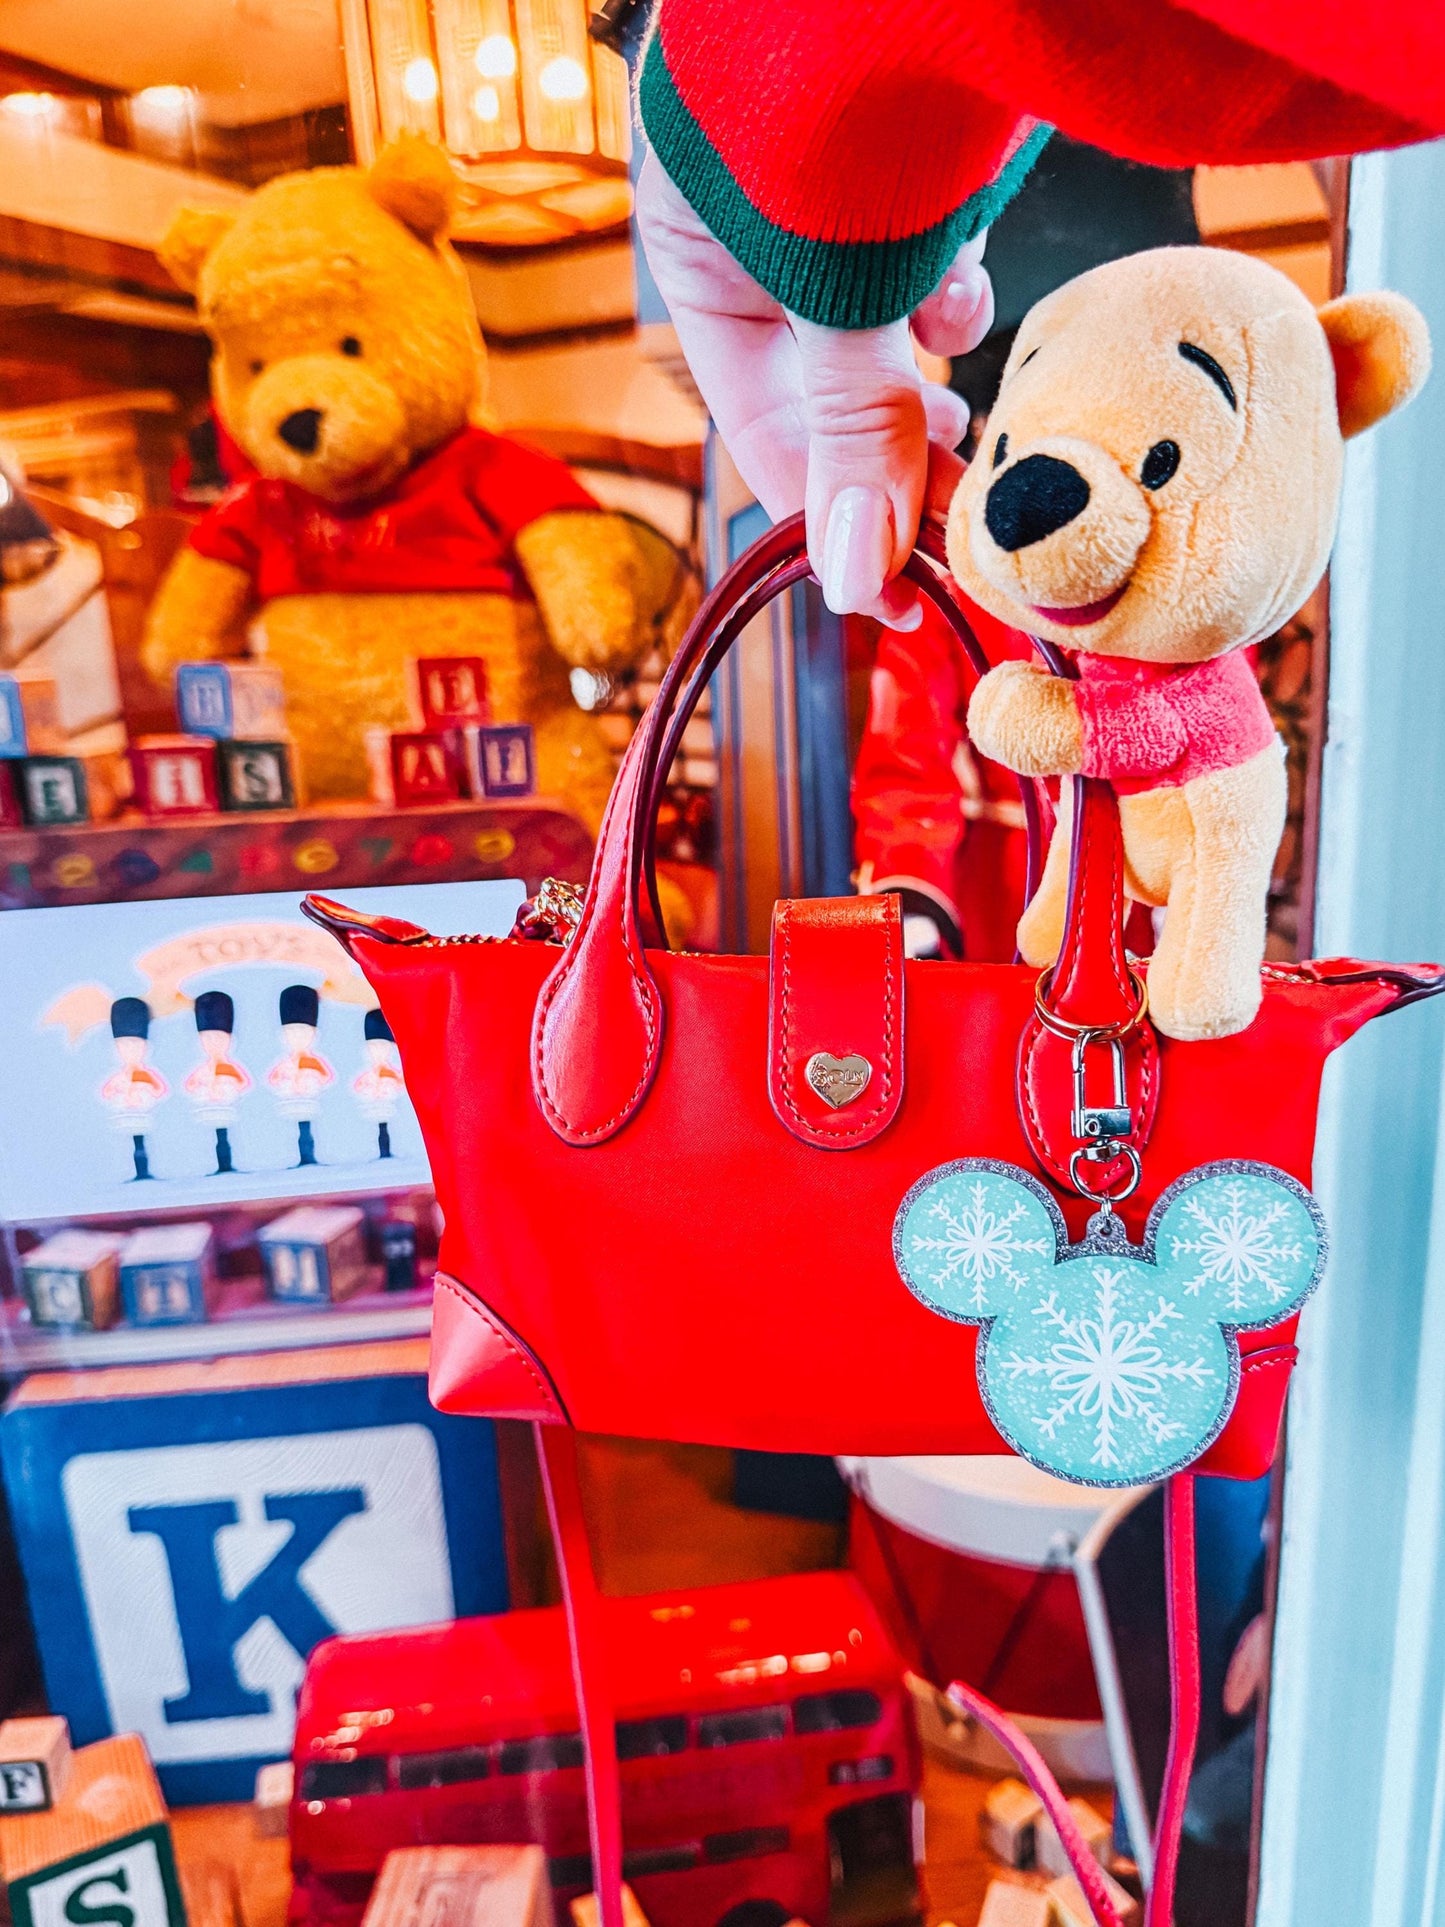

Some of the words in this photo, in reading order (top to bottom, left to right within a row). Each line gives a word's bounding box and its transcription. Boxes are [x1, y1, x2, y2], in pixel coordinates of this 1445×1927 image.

[127, 1484, 367, 1726] K
[2, 1766, 34, 1801] F
[64, 1866, 135, 1927] S
